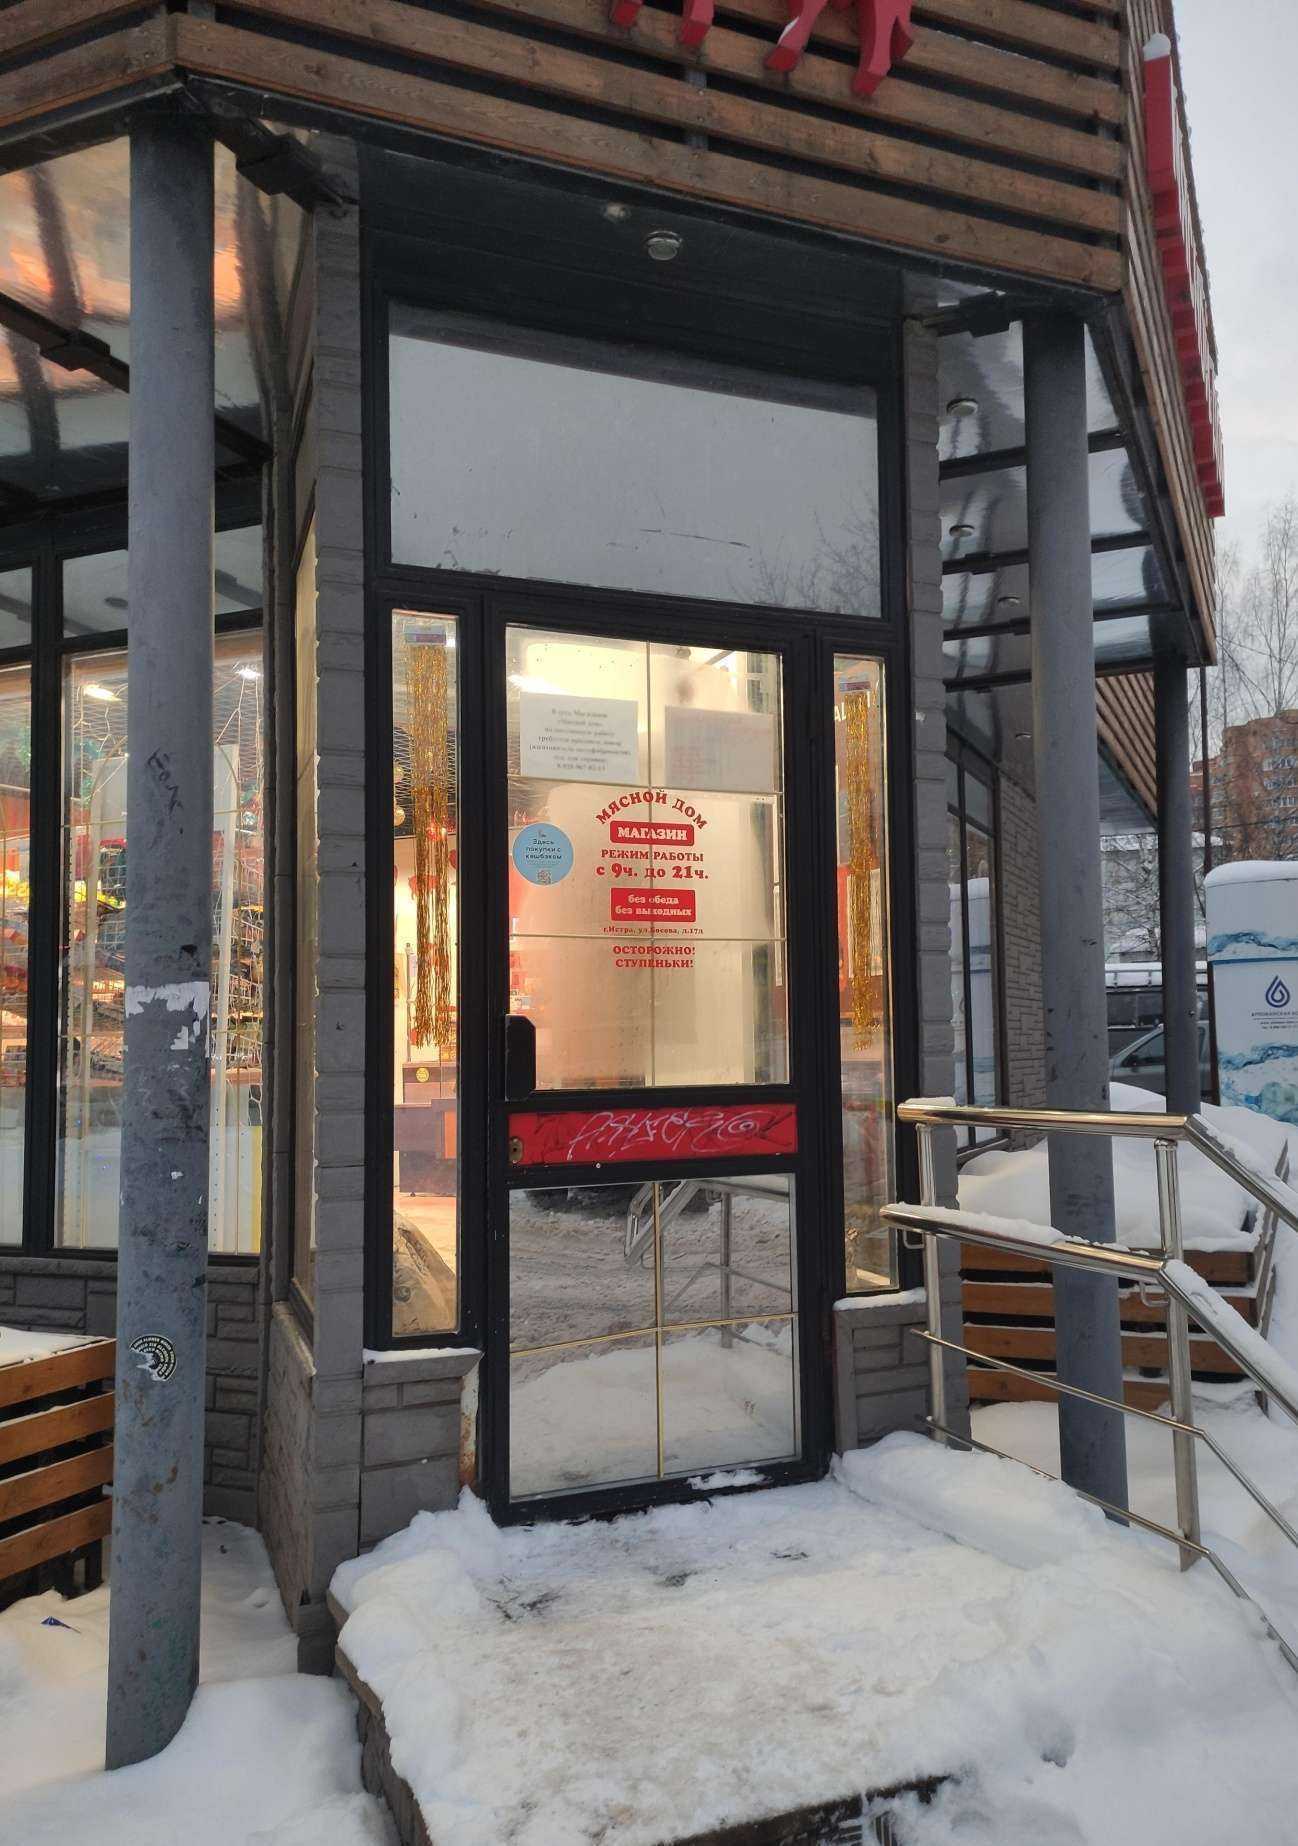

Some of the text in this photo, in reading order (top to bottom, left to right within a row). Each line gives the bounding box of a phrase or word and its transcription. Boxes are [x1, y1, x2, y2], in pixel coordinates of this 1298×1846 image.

[596, 788, 708, 829] МЯСНОЙ ДОМ
[617, 827, 688, 840] МАГАЗИН
[601, 849, 704, 861] РЕЖИМ РАБОТЫ
[596, 863, 709, 879] с 9ч. до 21ч.
[628, 894, 679, 905] без обеда
[615, 905, 692, 916] без выходных
[613, 945, 696, 955] ОСТОРОЖНО!
[615, 958, 694, 968] СТУПЕНЬКИ!
